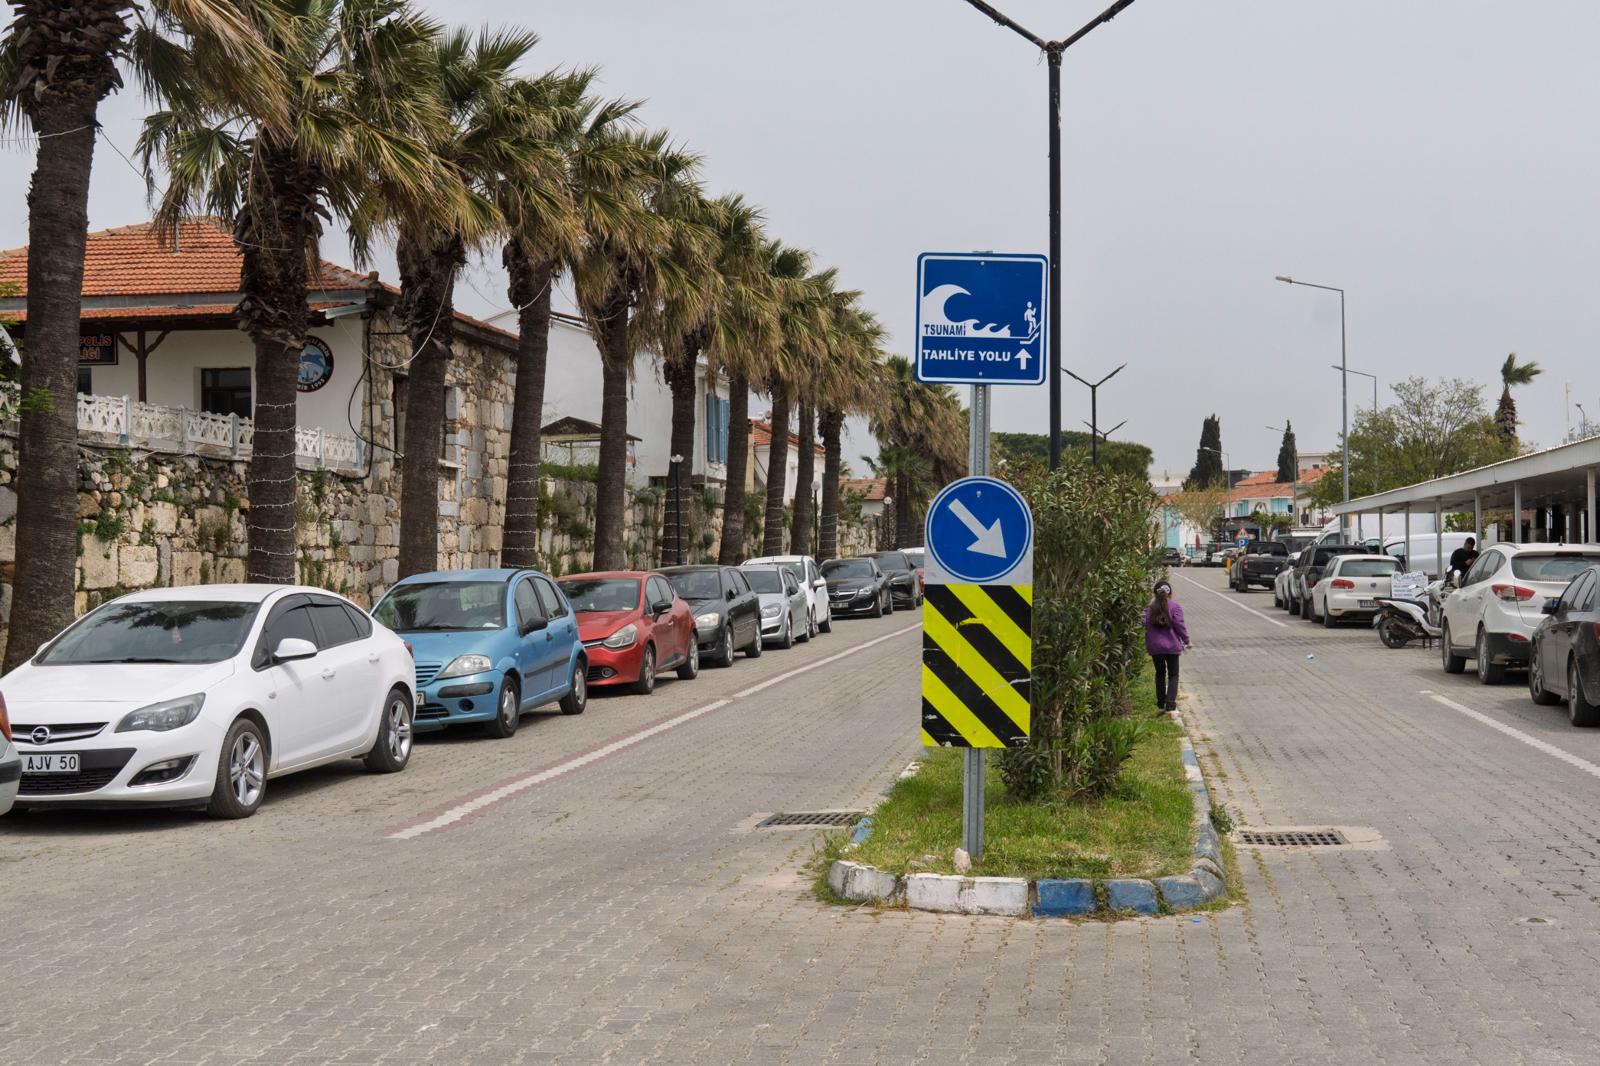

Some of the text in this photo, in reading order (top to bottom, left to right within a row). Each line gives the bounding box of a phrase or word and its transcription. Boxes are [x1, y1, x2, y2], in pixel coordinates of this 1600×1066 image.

[922, 348, 1011, 362] TAHLİYE YOLU
[27, 756, 77, 770] AJV 50
